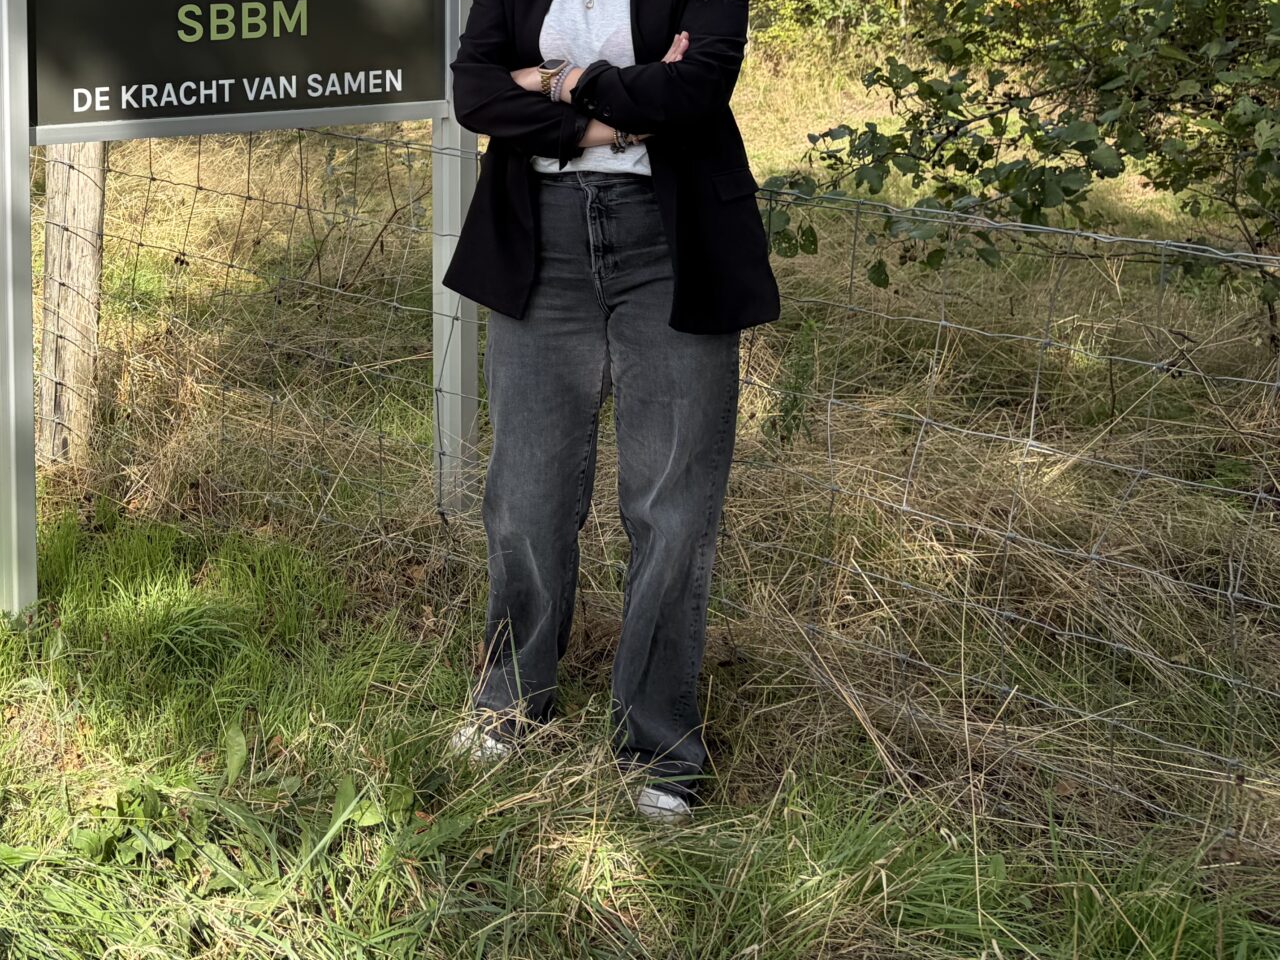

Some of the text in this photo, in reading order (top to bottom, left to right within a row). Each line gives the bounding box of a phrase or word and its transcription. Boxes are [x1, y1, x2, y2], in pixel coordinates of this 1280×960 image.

[176, 0, 309, 43] SBBM
[73, 69, 404, 113] DE KRACHT VAN SAMEN
